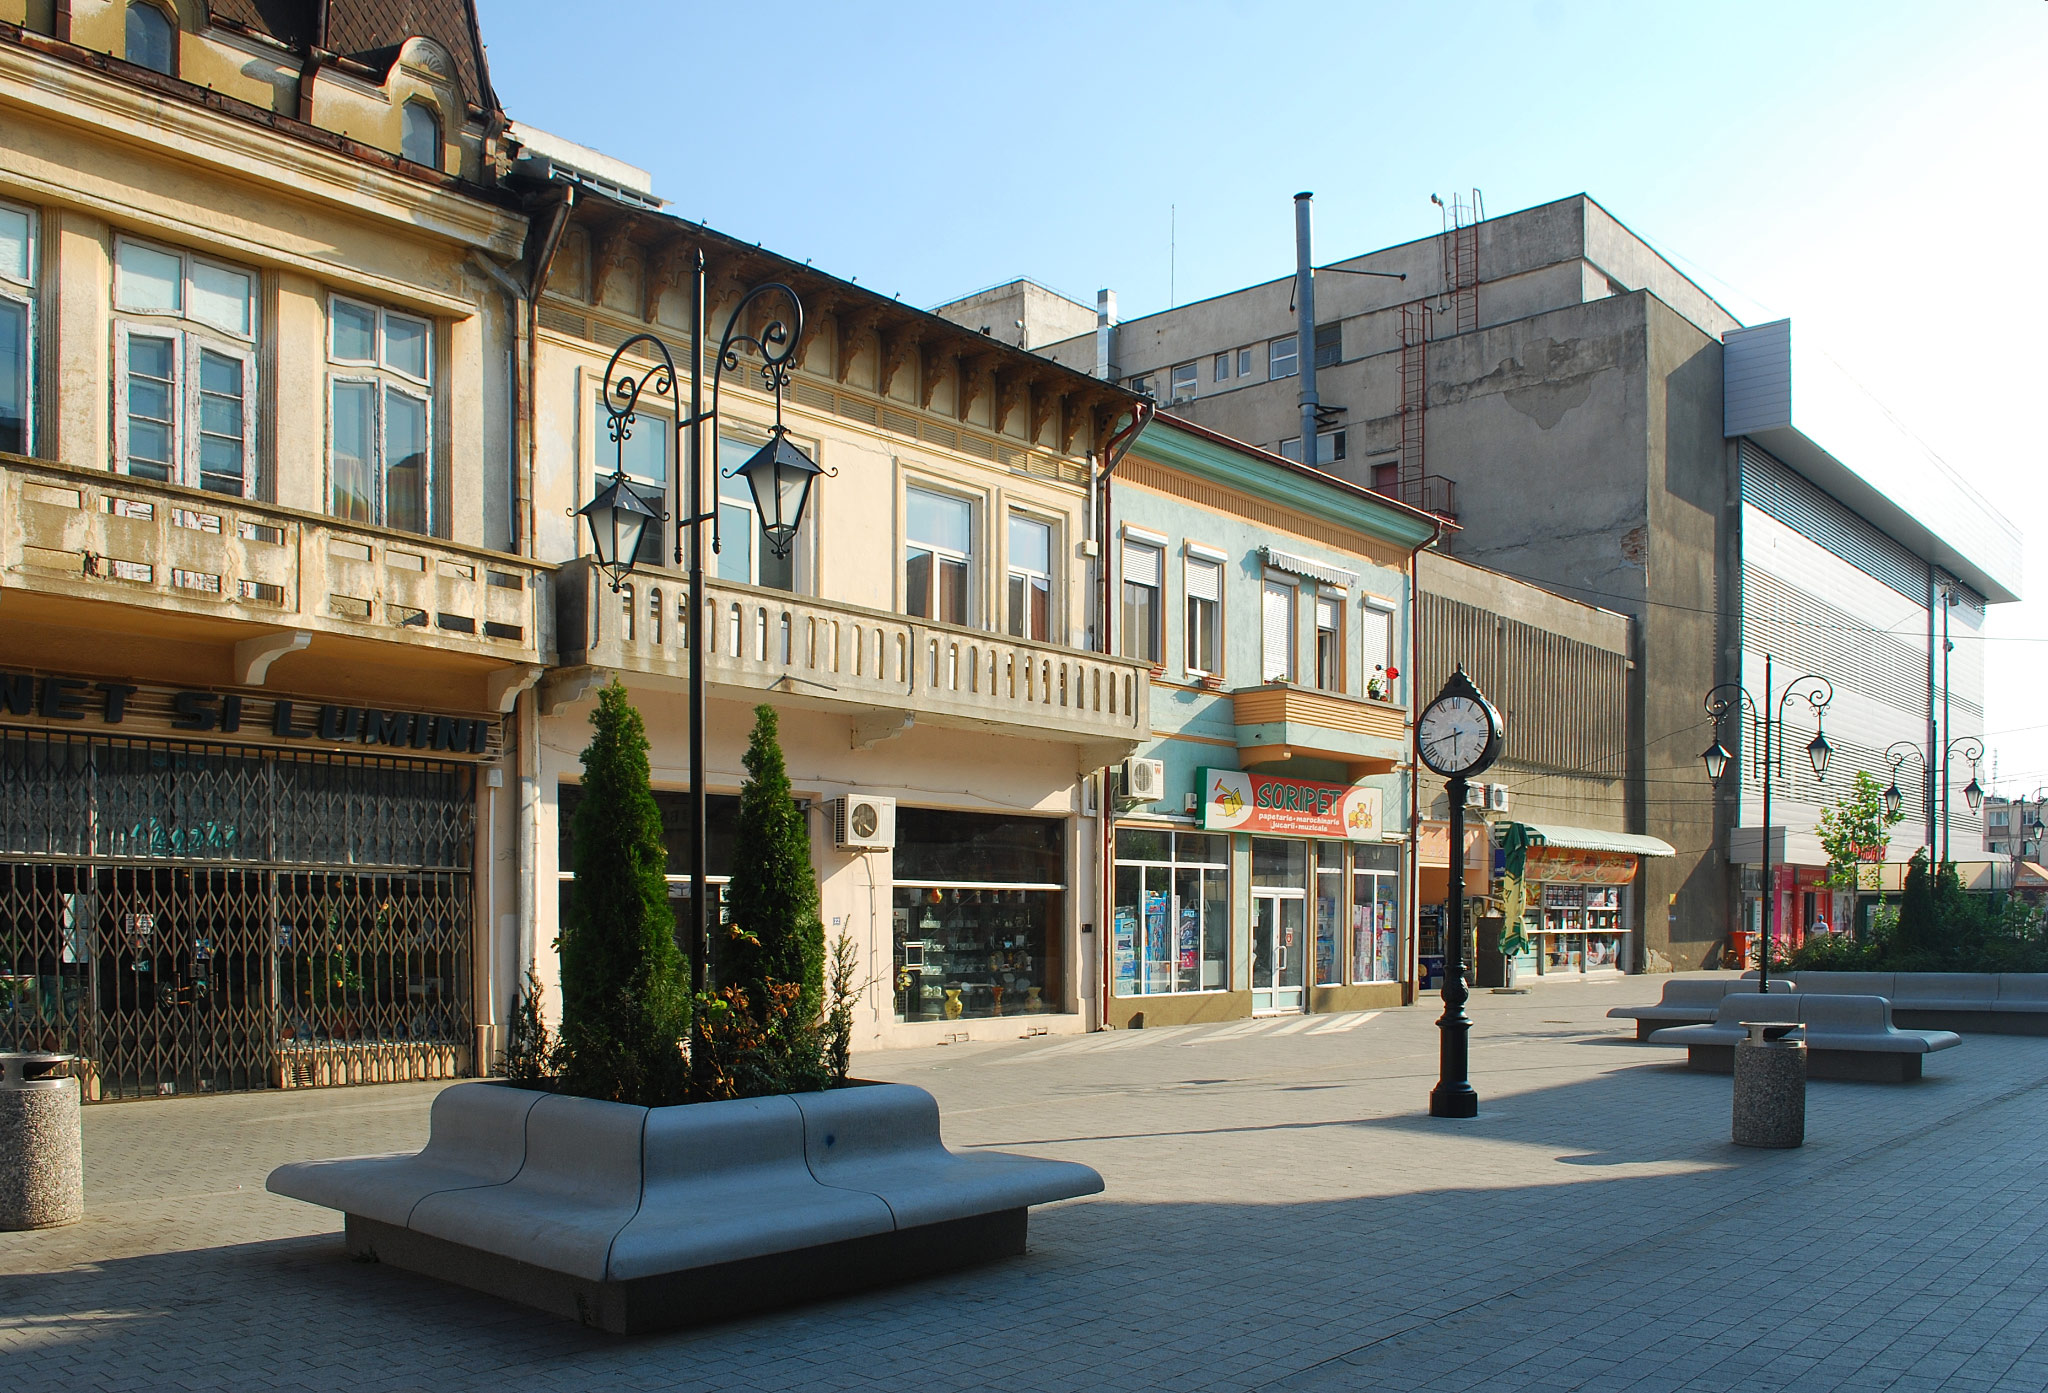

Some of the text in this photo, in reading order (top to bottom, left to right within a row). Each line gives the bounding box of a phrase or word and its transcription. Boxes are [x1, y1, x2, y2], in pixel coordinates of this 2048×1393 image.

[171, 691, 242, 732] SI
[272, 700, 489, 753] LUMINI
[1257, 783, 1341, 815] SORIPET
[1259, 813, 1340, 825] papetarie marochinarie
[1298, 824, 1328, 832] muzicale
